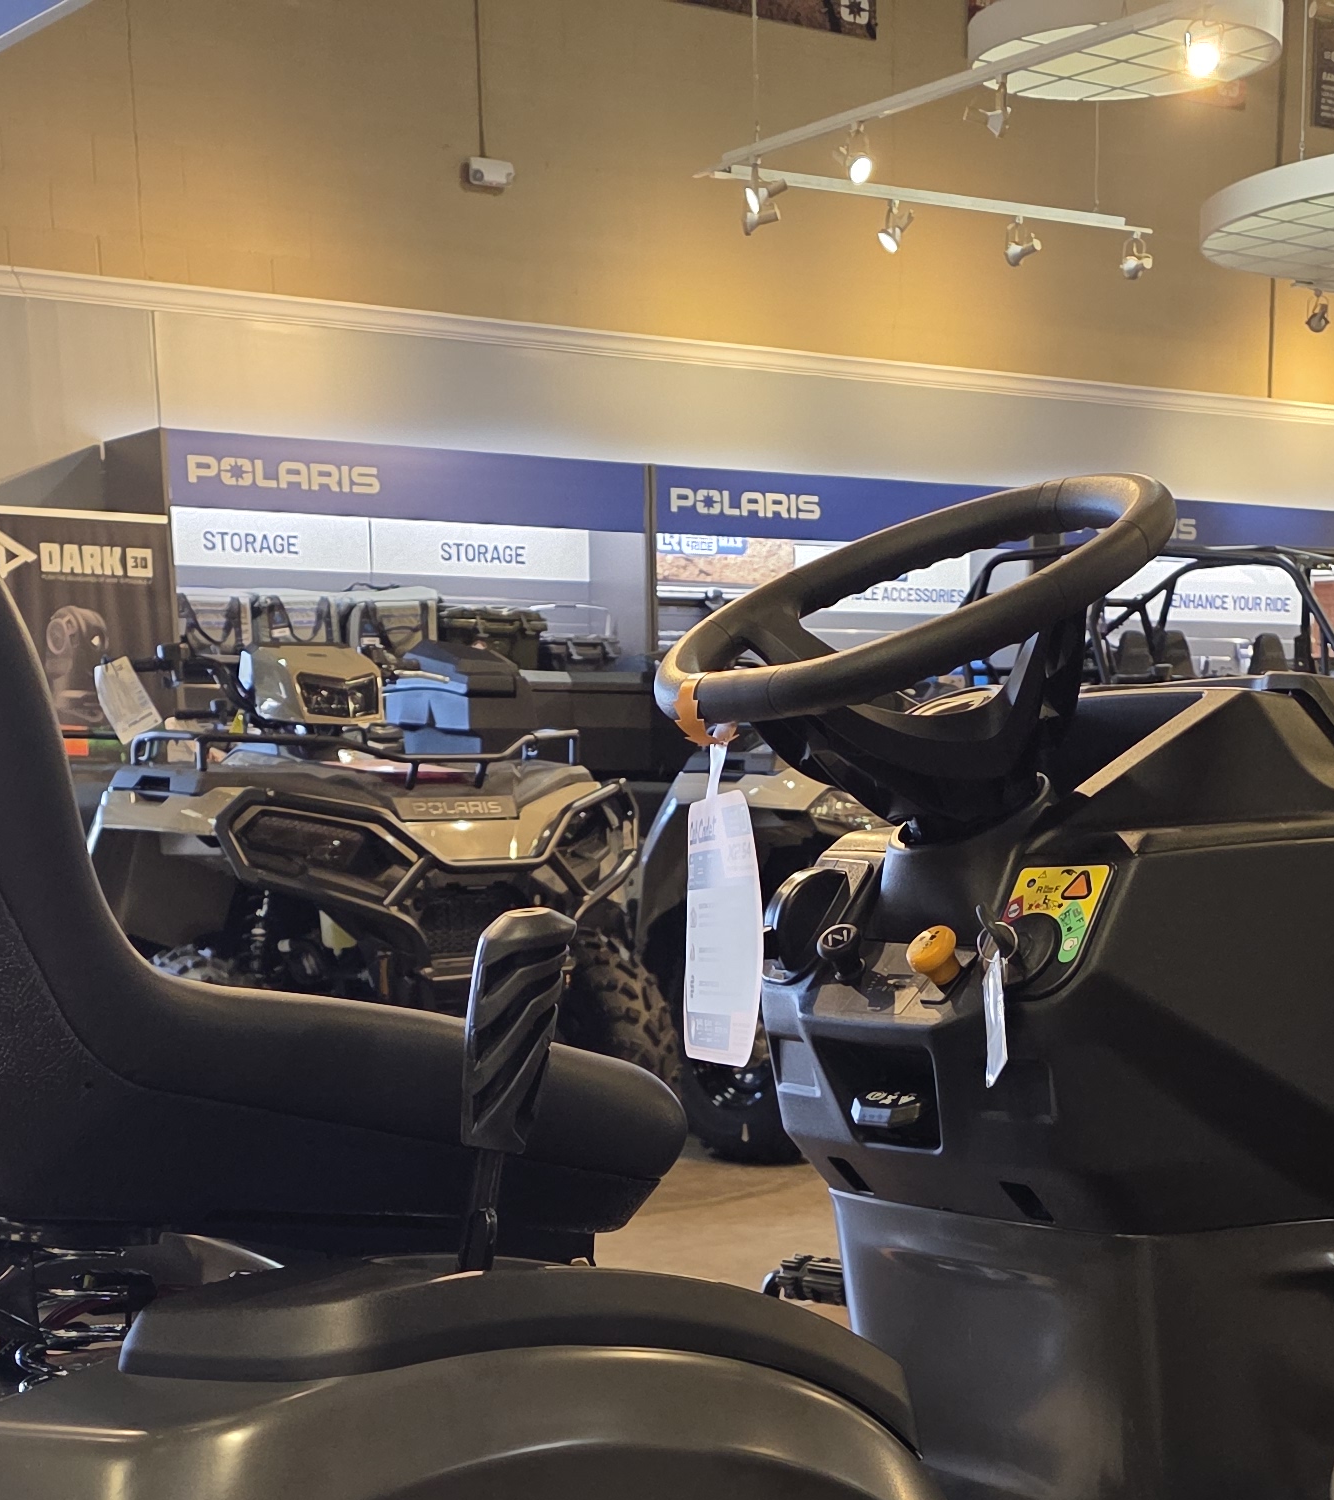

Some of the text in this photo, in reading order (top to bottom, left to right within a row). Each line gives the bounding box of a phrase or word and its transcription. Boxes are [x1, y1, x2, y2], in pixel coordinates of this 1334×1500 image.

[187, 454, 381, 494] POLARIS
[670, 487, 821, 520] POLARIS
[202, 530, 299, 555] STORAGE
[440, 542, 526, 565] STORAGE
[39, 542, 124, 576] DARK
[882, 587, 965, 604] ACCESSORIES
[1171, 592, 1291, 613] ENHANCE YOUR RIDE
[412, 801, 503, 814] POLARIS
